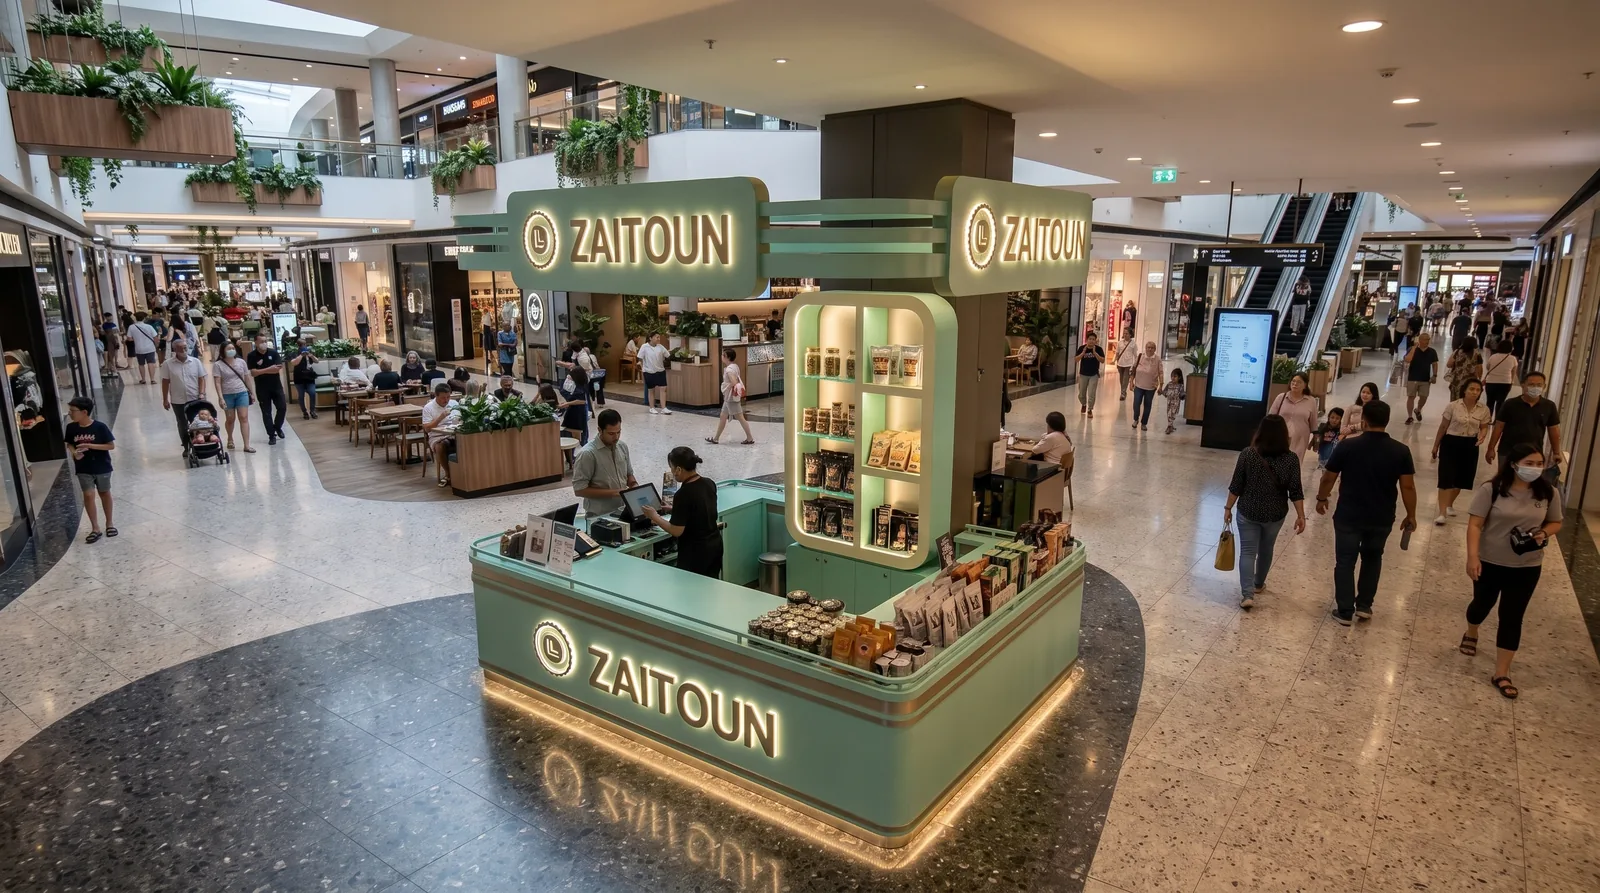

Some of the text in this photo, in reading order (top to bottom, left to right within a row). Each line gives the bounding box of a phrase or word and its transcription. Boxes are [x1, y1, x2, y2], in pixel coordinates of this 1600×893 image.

[570, 214, 733, 265] ZAITOUN
[1002, 215, 1087, 262] ZAITOUN
[588, 644, 779, 759] ZAITOUN
